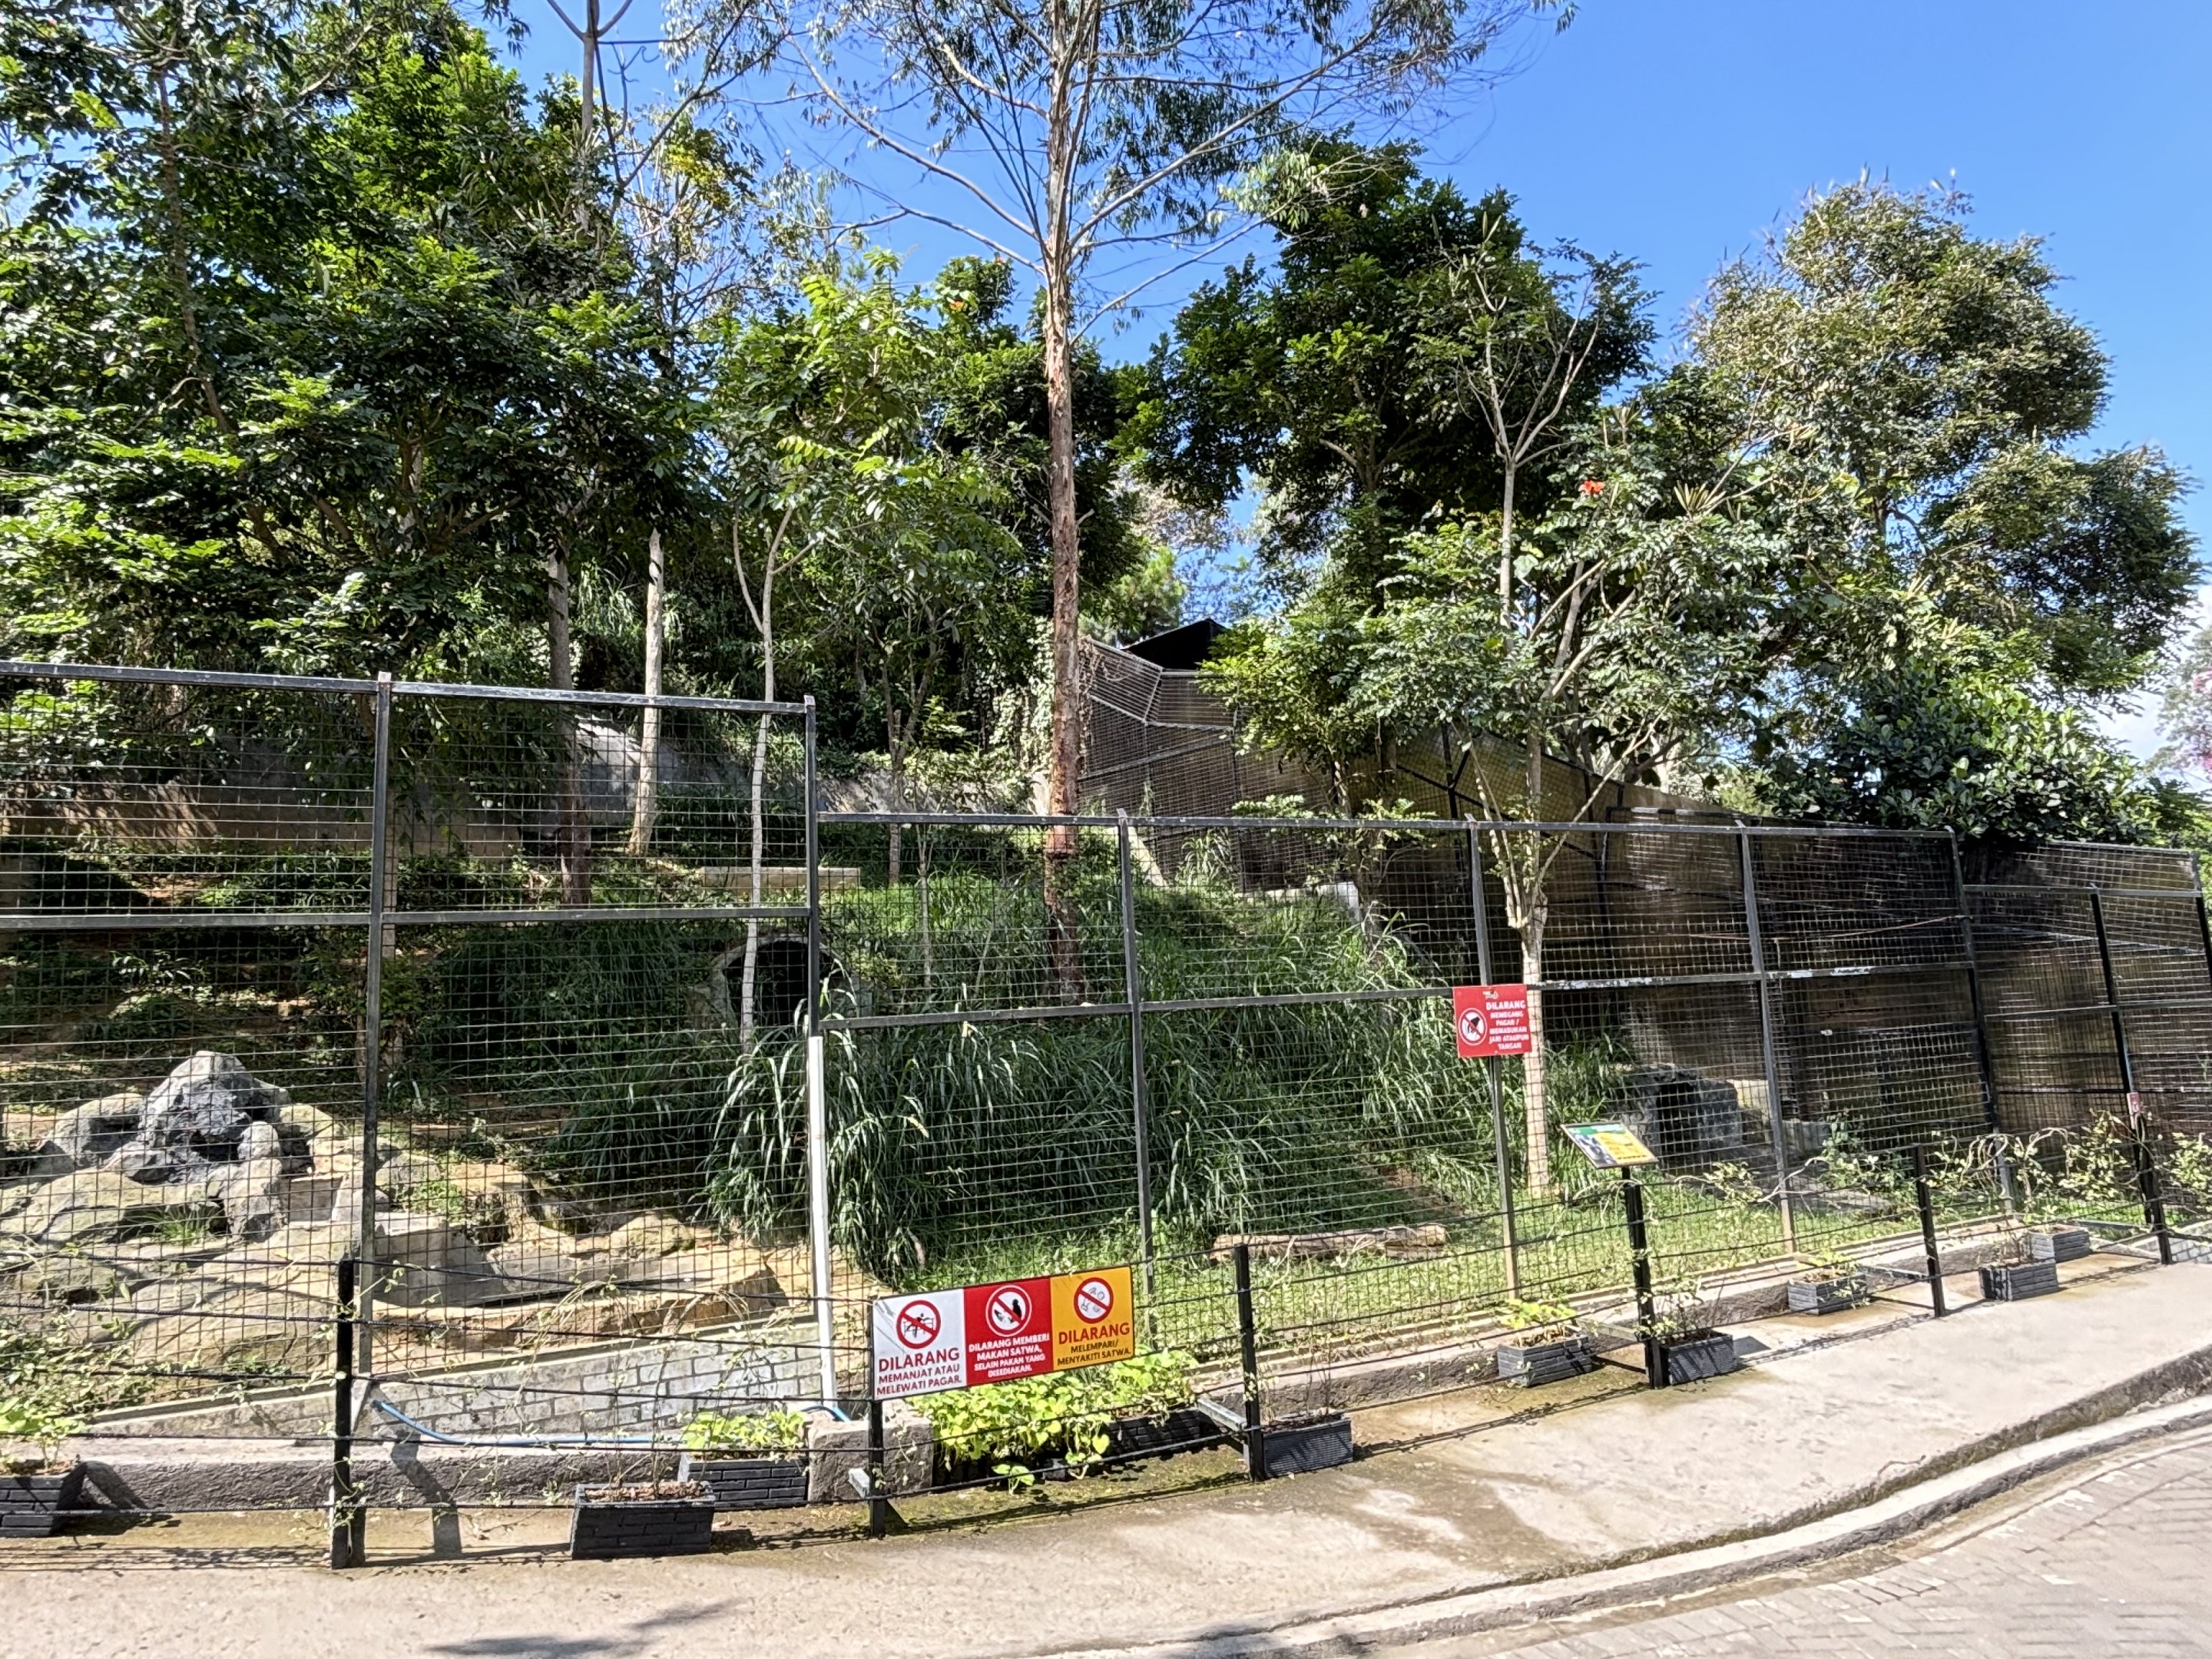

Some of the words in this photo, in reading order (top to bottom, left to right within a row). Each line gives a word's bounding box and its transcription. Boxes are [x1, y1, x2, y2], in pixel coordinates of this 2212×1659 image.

[1486, 1000, 1525, 1010] DILARANG
[969, 1339, 1012, 1352] DILARANG
[1012, 1333, 1050, 1346] MEMBERI
[1058, 1322, 1130, 1345] DILARANG
[976, 1349, 1008, 1361] MAKAN
[1010, 1344, 1042, 1356] SATWA,
[1071, 1339, 1118, 1353] MELEMPARI/
[879, 1347, 960, 1373] DILARANG
[974, 1360, 999, 1371] SELAIN
[1000, 1356, 1024, 1367] PAKAN
[1025, 1353, 1045, 1363] YANG
[1057, 1353, 1100, 1366] MENYAKITI
[1102, 1348, 1131, 1359] SATWA.
[879, 1368, 932, 1384] MEMANJAT
[935, 1364, 959, 1376] ATAU
[988, 1365, 1032, 1377] DISEDIAKAN.
[876, 1380, 926, 1395] MELEWATI
[928, 1375, 962, 1389] PAGAR.
